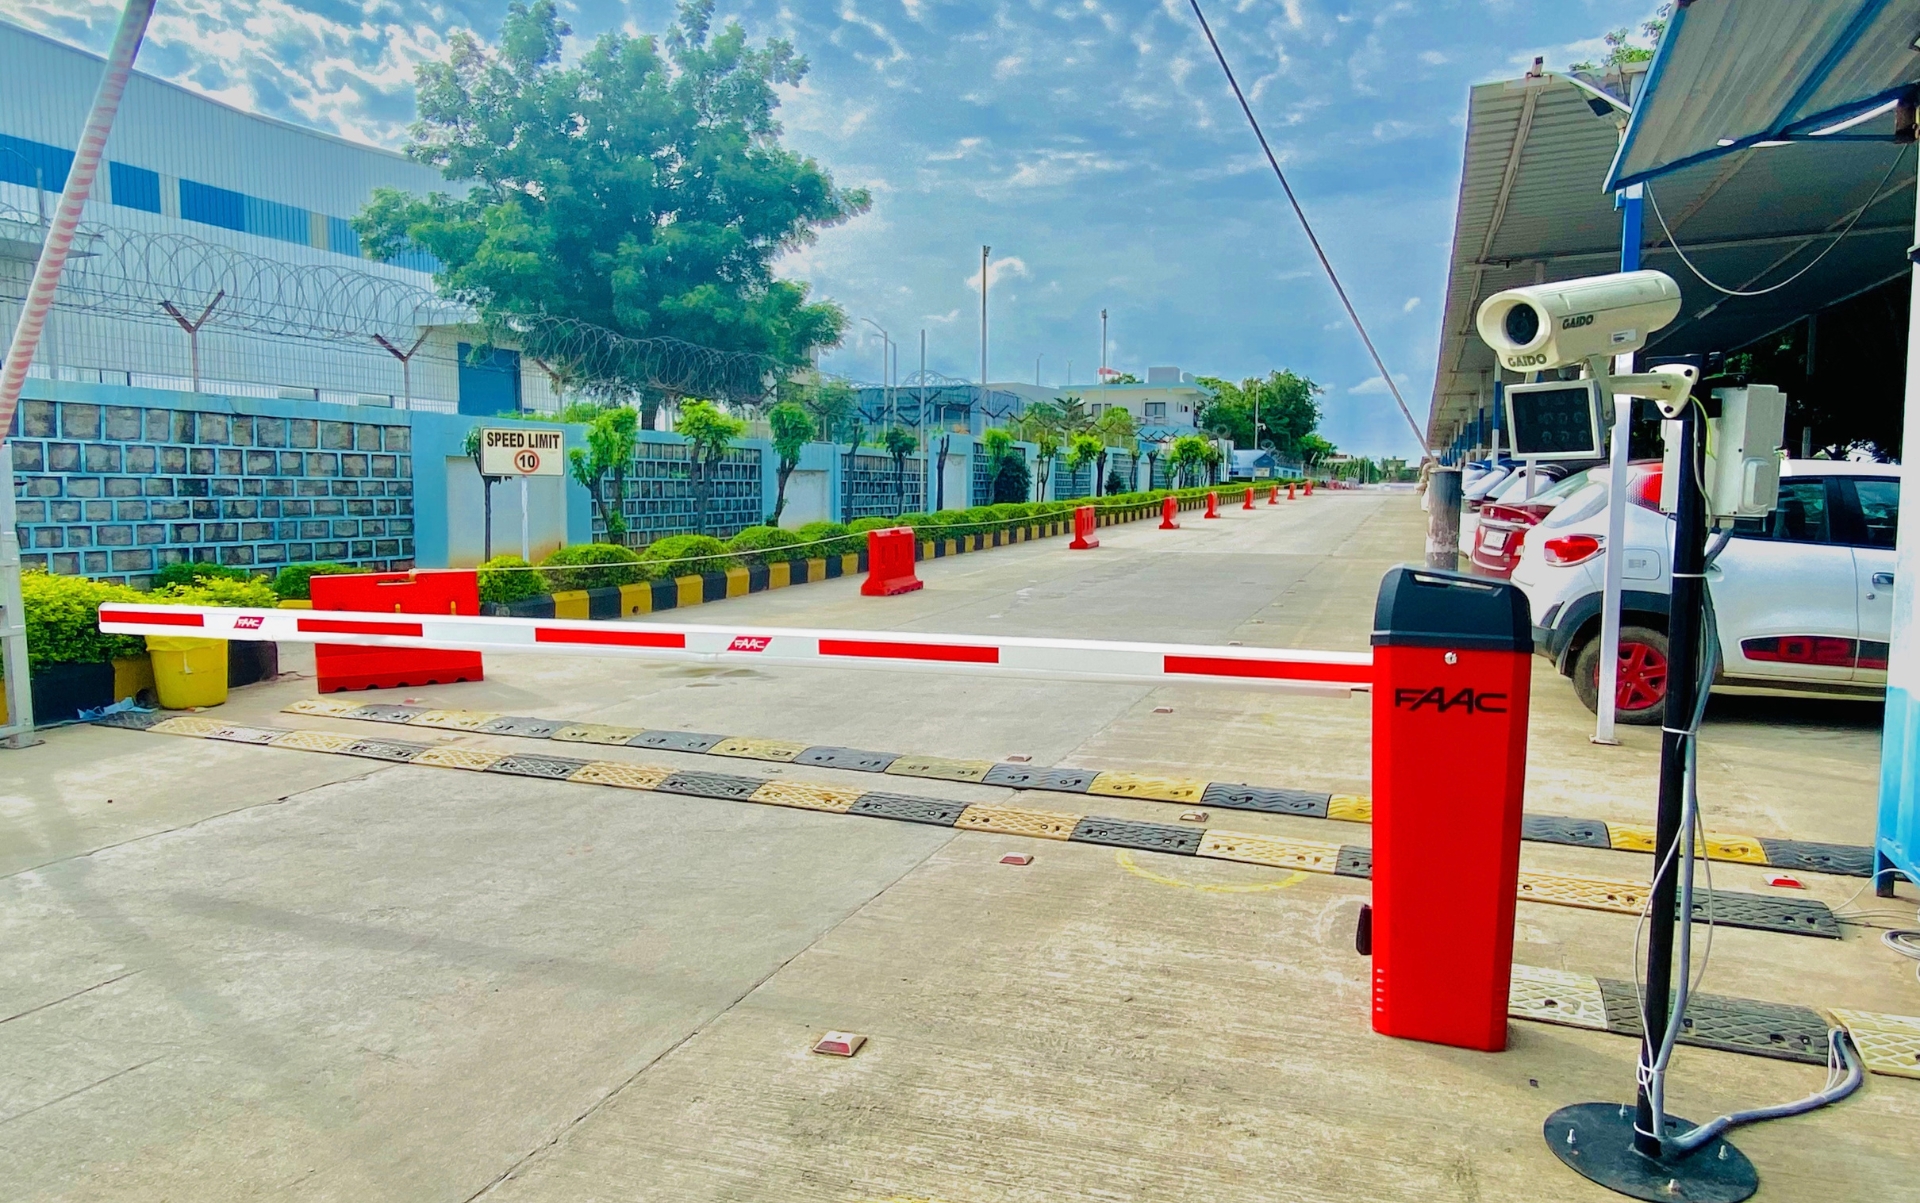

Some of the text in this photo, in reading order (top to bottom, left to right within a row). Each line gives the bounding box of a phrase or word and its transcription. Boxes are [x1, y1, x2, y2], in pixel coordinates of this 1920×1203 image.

[1562, 314, 1594, 330] GAIDO
[1507, 353, 1547, 368] GAIDO
[487, 431, 560, 449] SPEED LIMIT
[519, 454, 536, 468] 10
[734, 638, 765, 649] FAAC
[1395, 686, 1507, 715] FAAC
